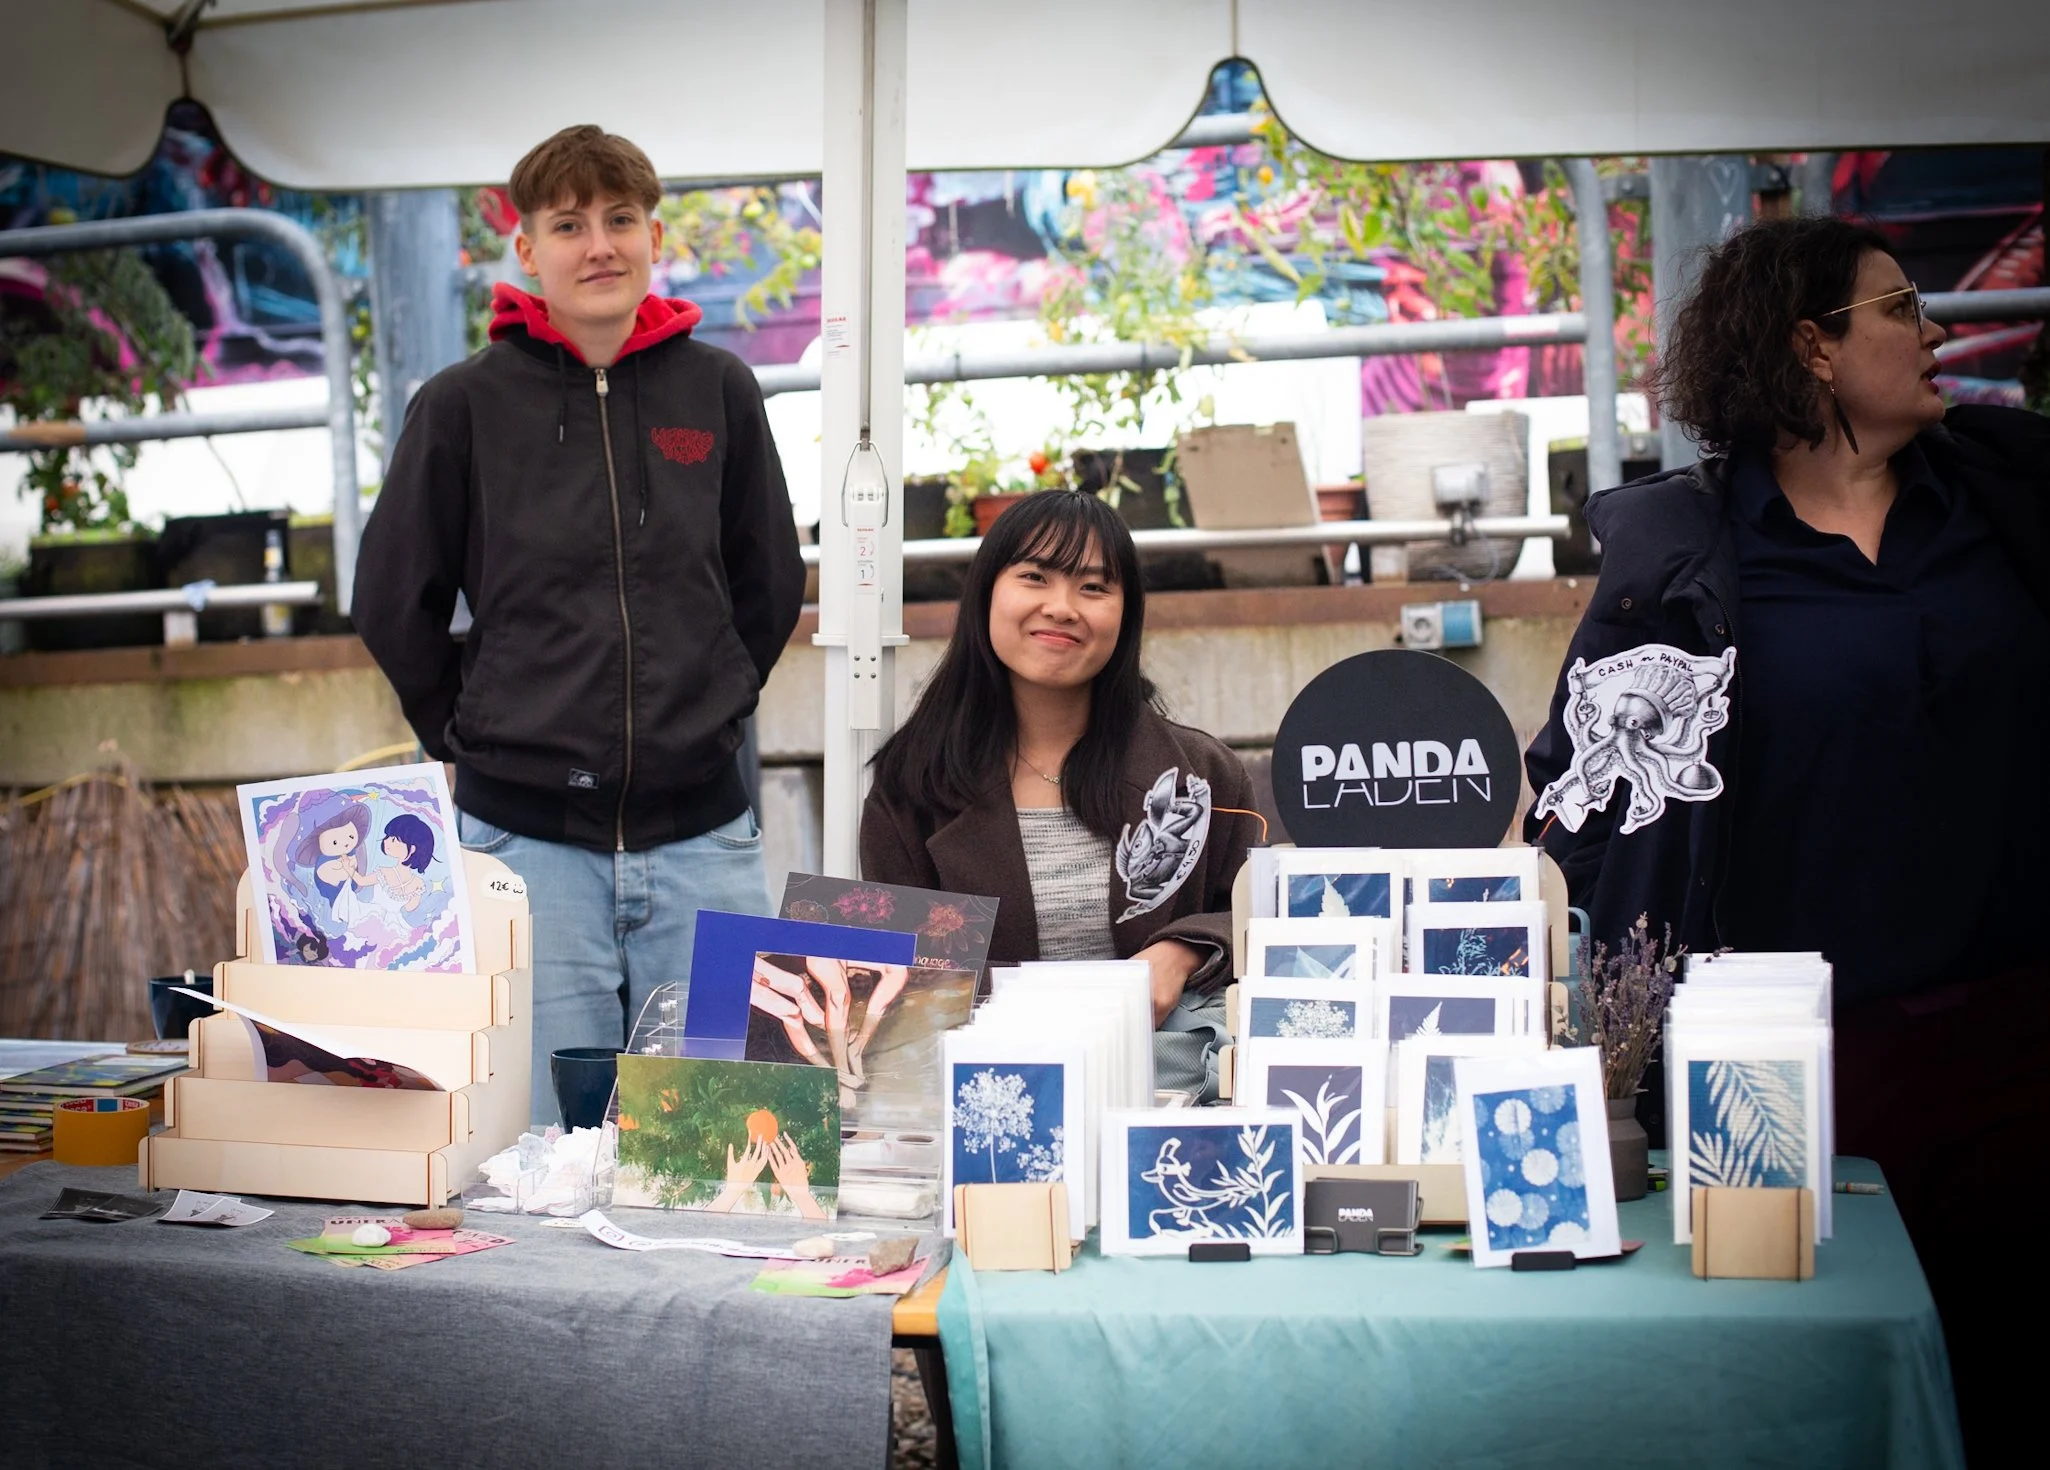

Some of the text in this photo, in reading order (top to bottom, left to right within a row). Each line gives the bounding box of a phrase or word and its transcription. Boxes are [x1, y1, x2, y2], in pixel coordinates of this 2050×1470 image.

[860, 546, 866, 556] 2
[1598, 659, 1634, 677] CASH
[1660, 652, 1693, 672] PAYPAL
[1301, 738, 1490, 782] PANDA
[1303, 777, 1491, 809] LADEN
[490, 880, 509, 891] 12€
[1338, 1207, 1374, 1218] PANDA
